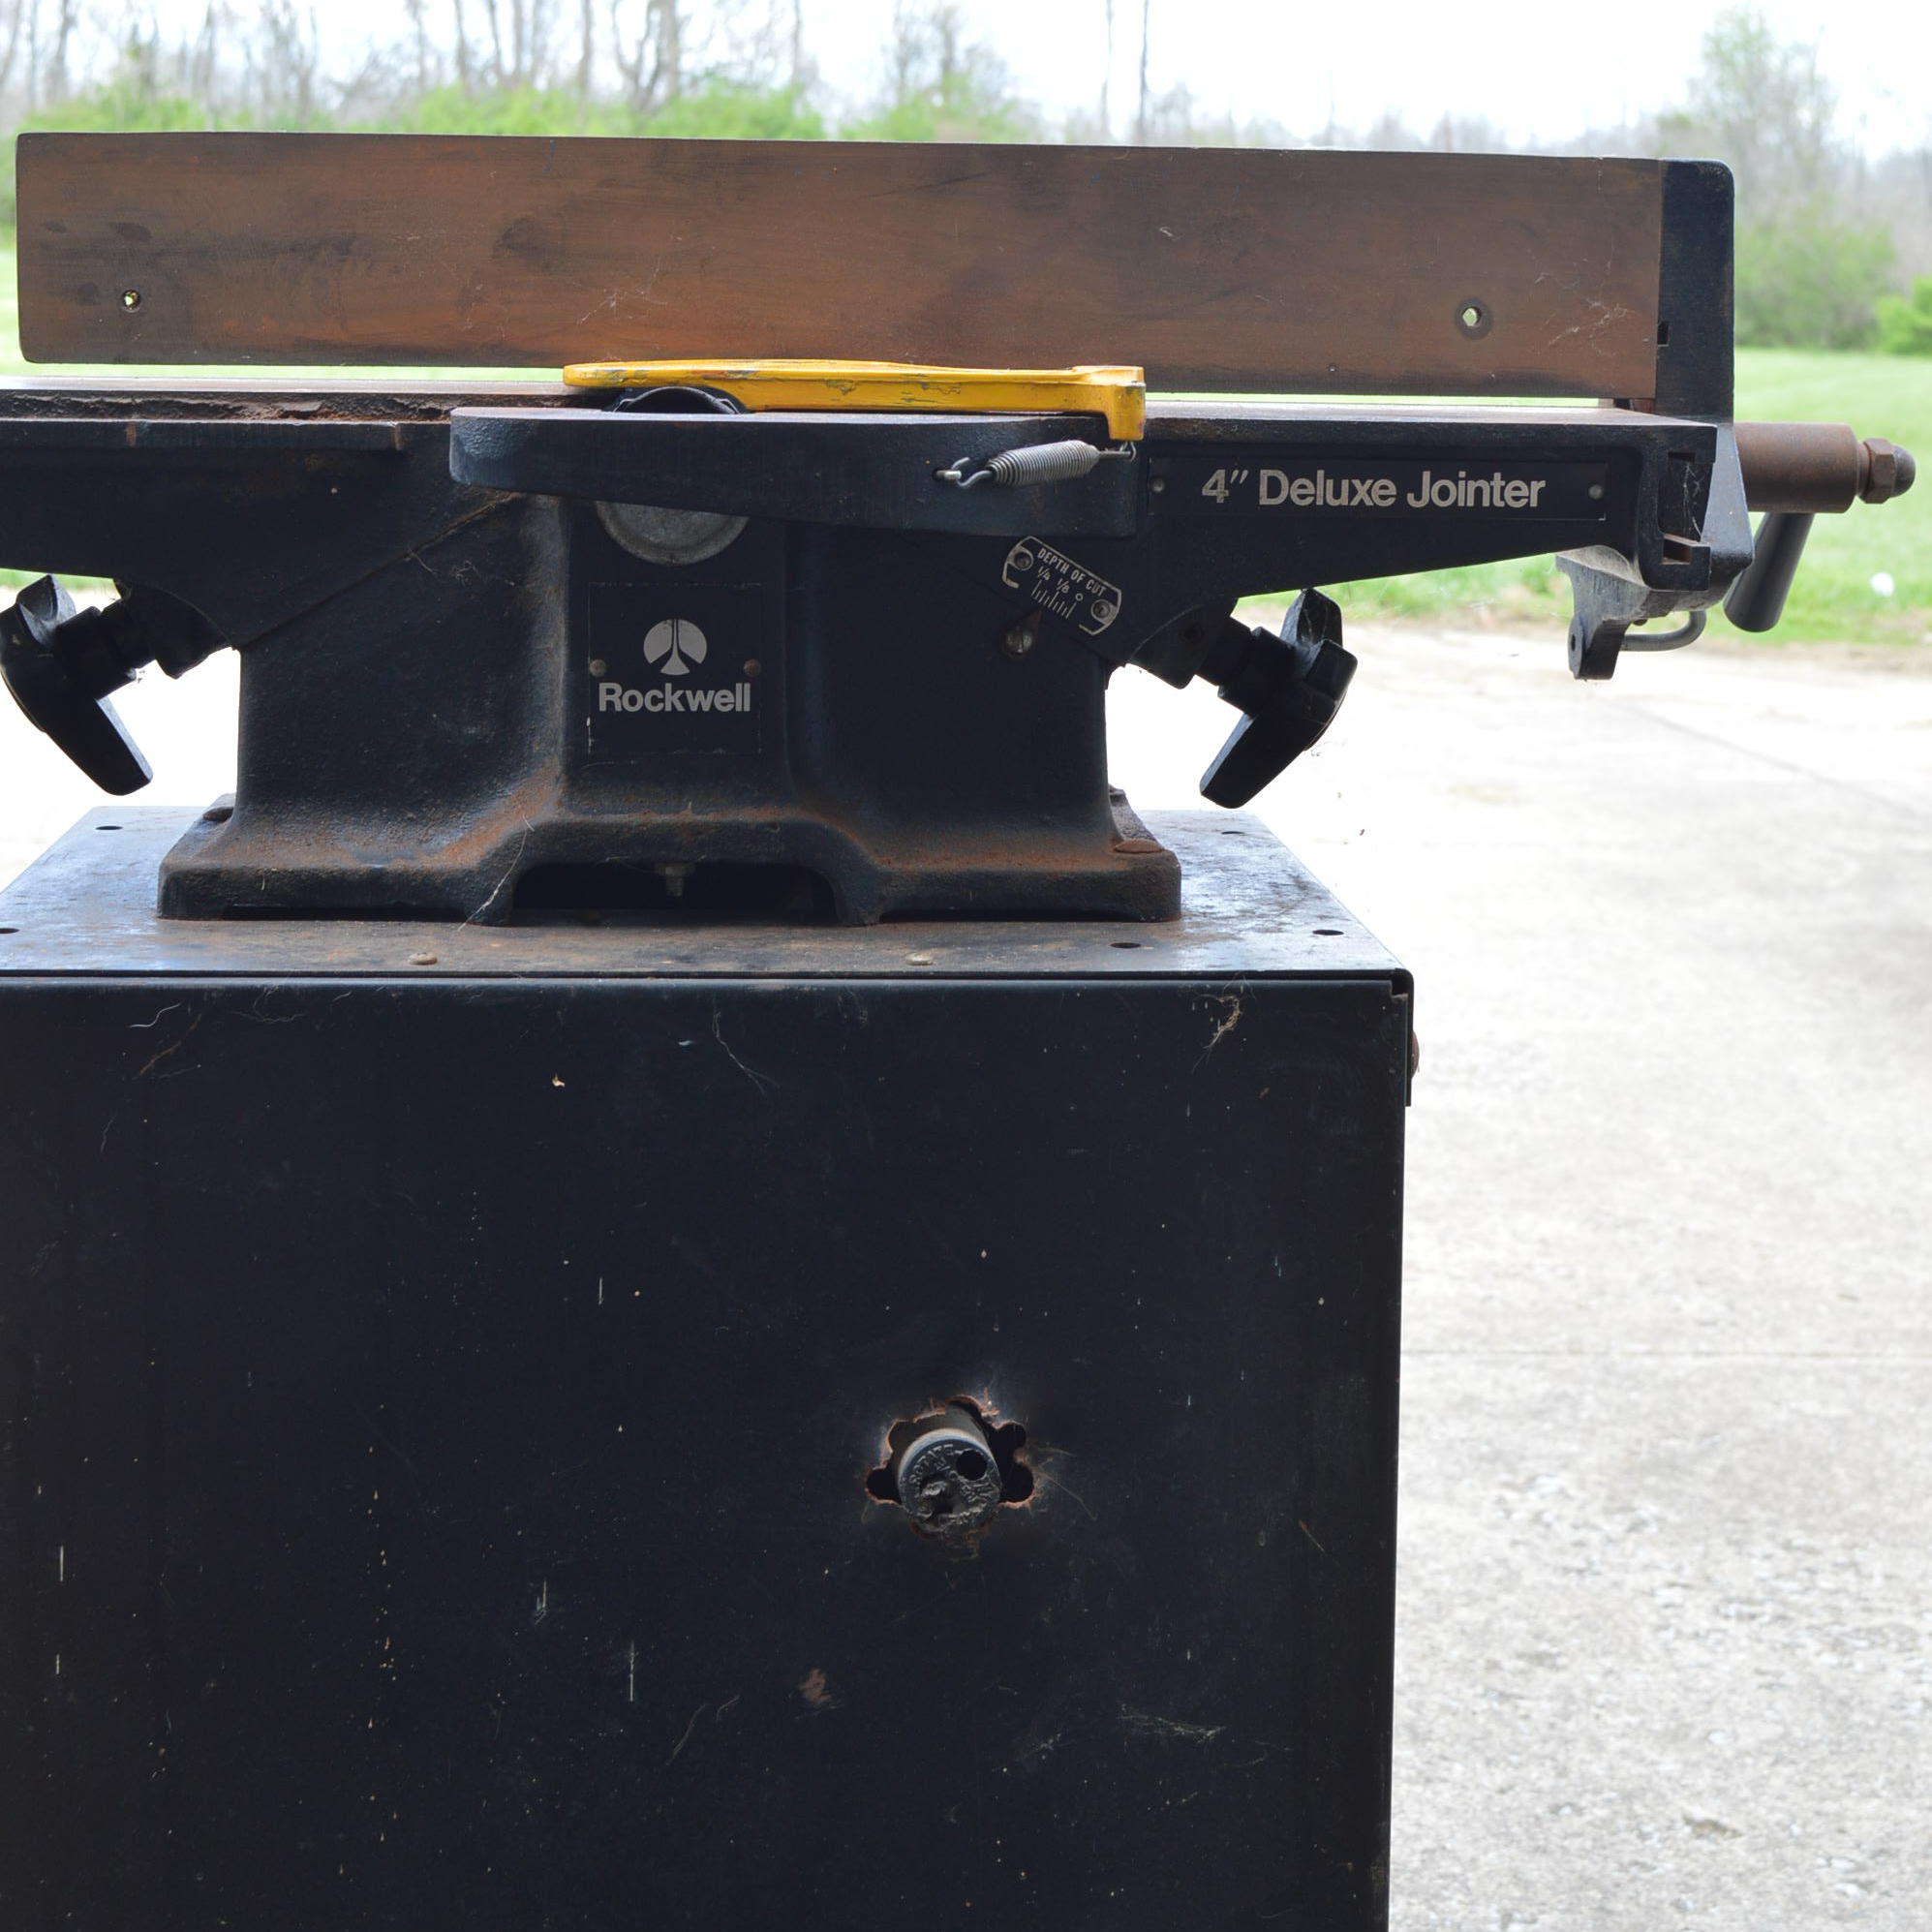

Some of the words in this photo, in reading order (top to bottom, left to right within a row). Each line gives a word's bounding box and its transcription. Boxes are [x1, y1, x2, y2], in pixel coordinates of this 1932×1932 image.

[1259, 469, 1396, 506] Deluxe
[1407, 471, 1546, 507] Jointer
[1037, 547, 1070, 574] DEPTH
[1070, 569, 1086, 583] OF
[1086, 579, 1107, 597] CUT
[1037, 566, 1052, 581] 1/4
[1057, 578, 1069, 594] 1/8
[598, 682, 751, 712] Rockwell
